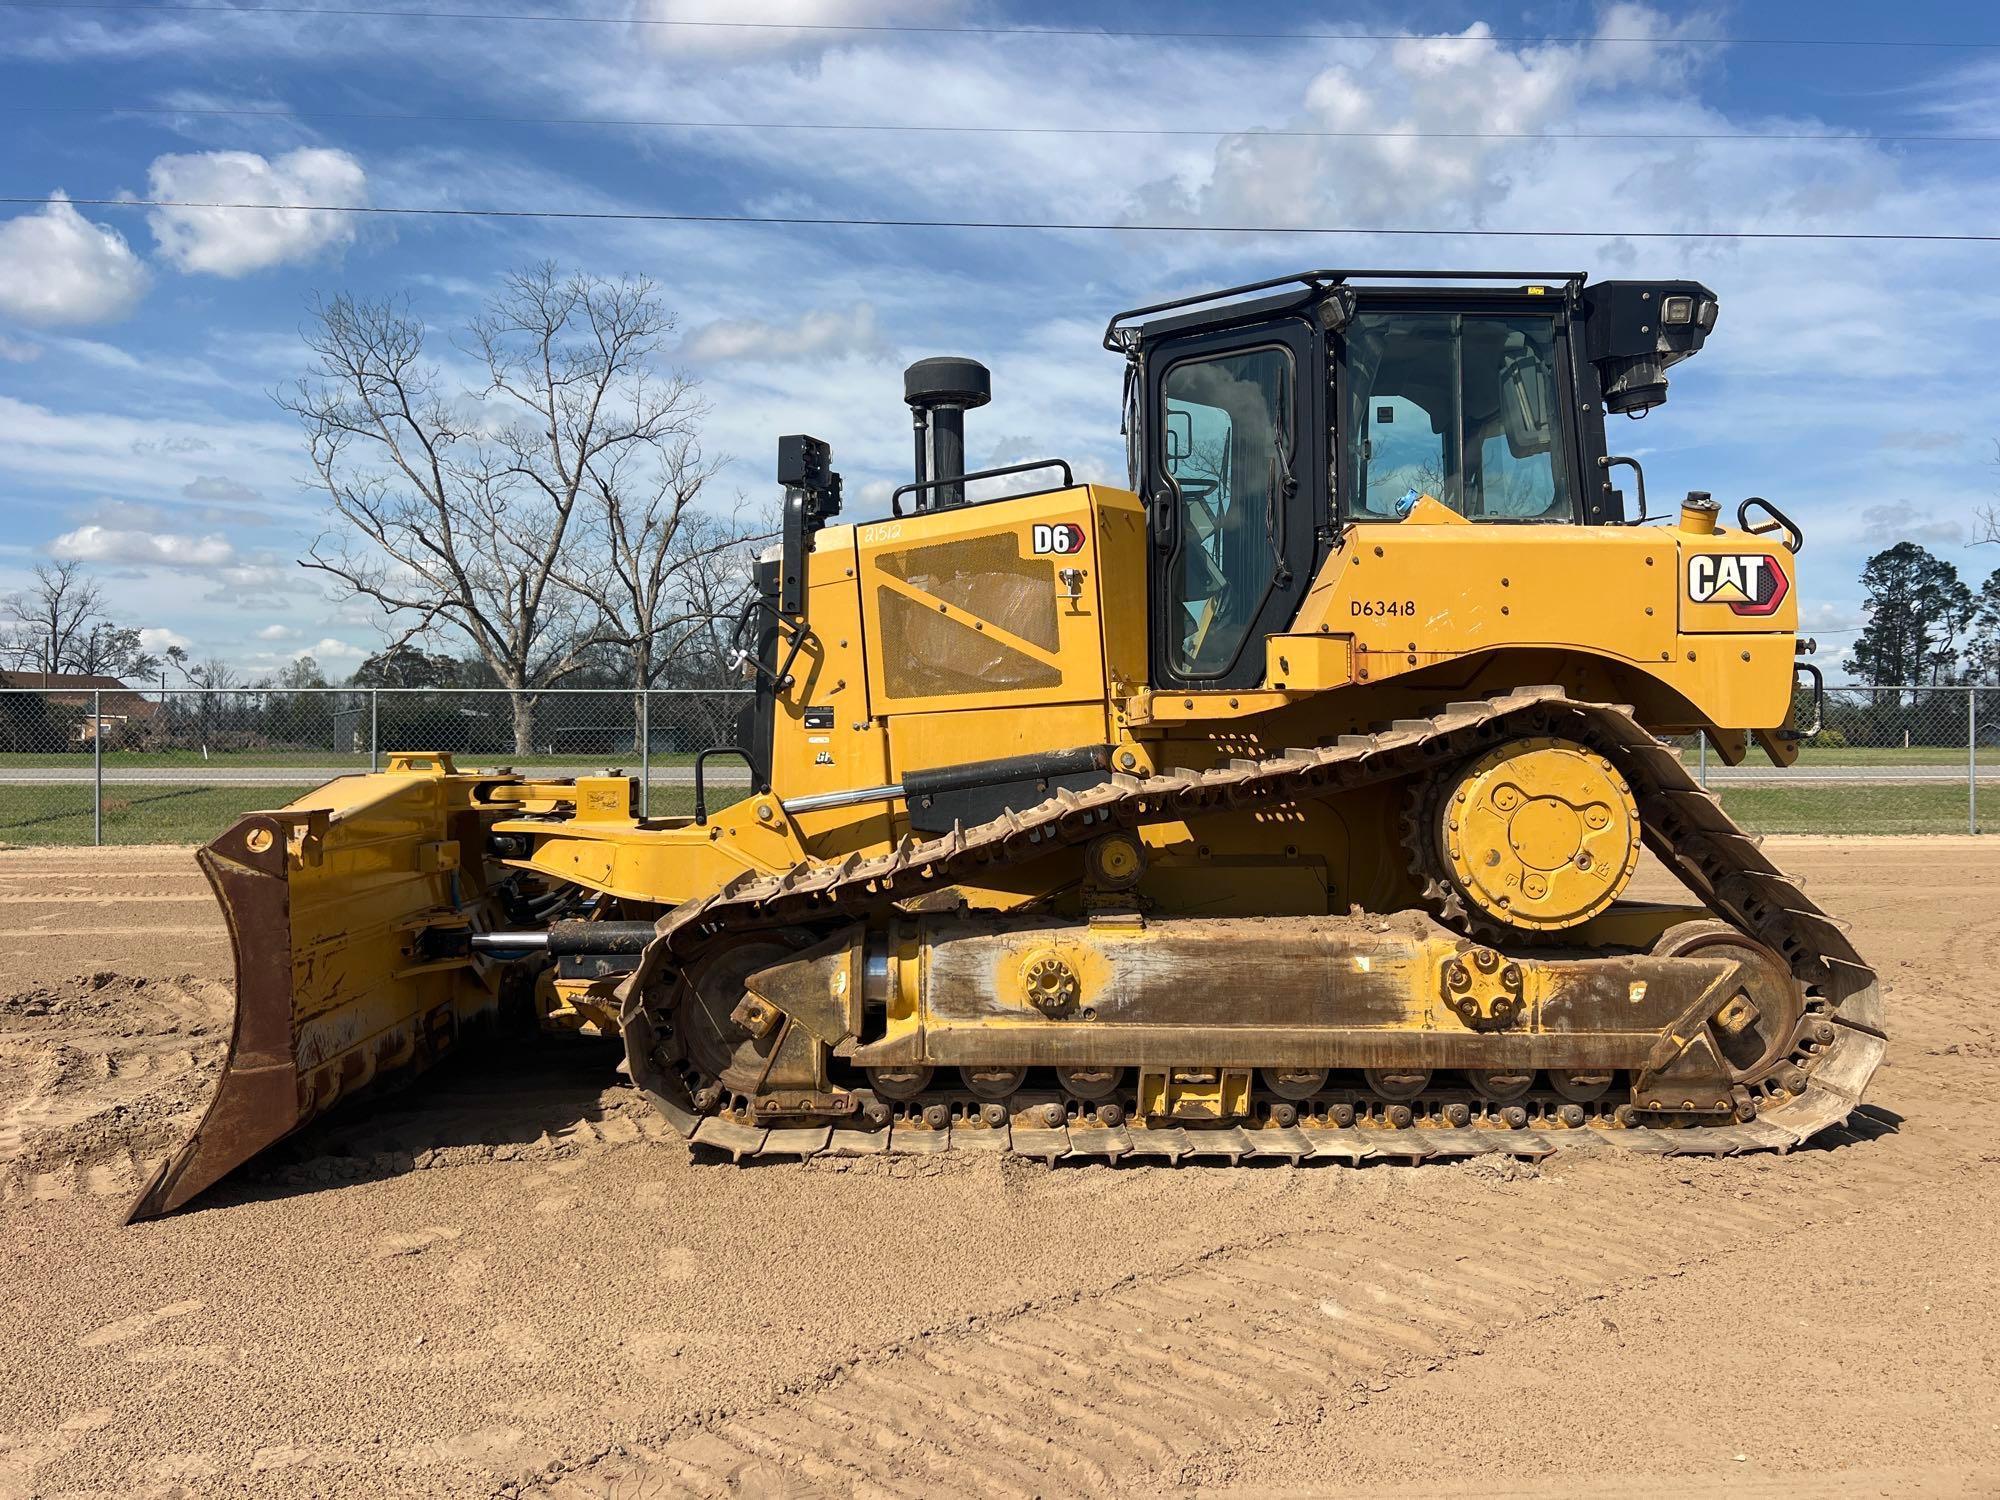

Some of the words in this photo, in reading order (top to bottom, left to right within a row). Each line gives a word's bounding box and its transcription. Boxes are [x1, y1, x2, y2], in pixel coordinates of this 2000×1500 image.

[1034, 525, 1069, 553] D6
[1689, 555, 1764, 602] CAT
[1351, 600, 1416, 617] D63418
